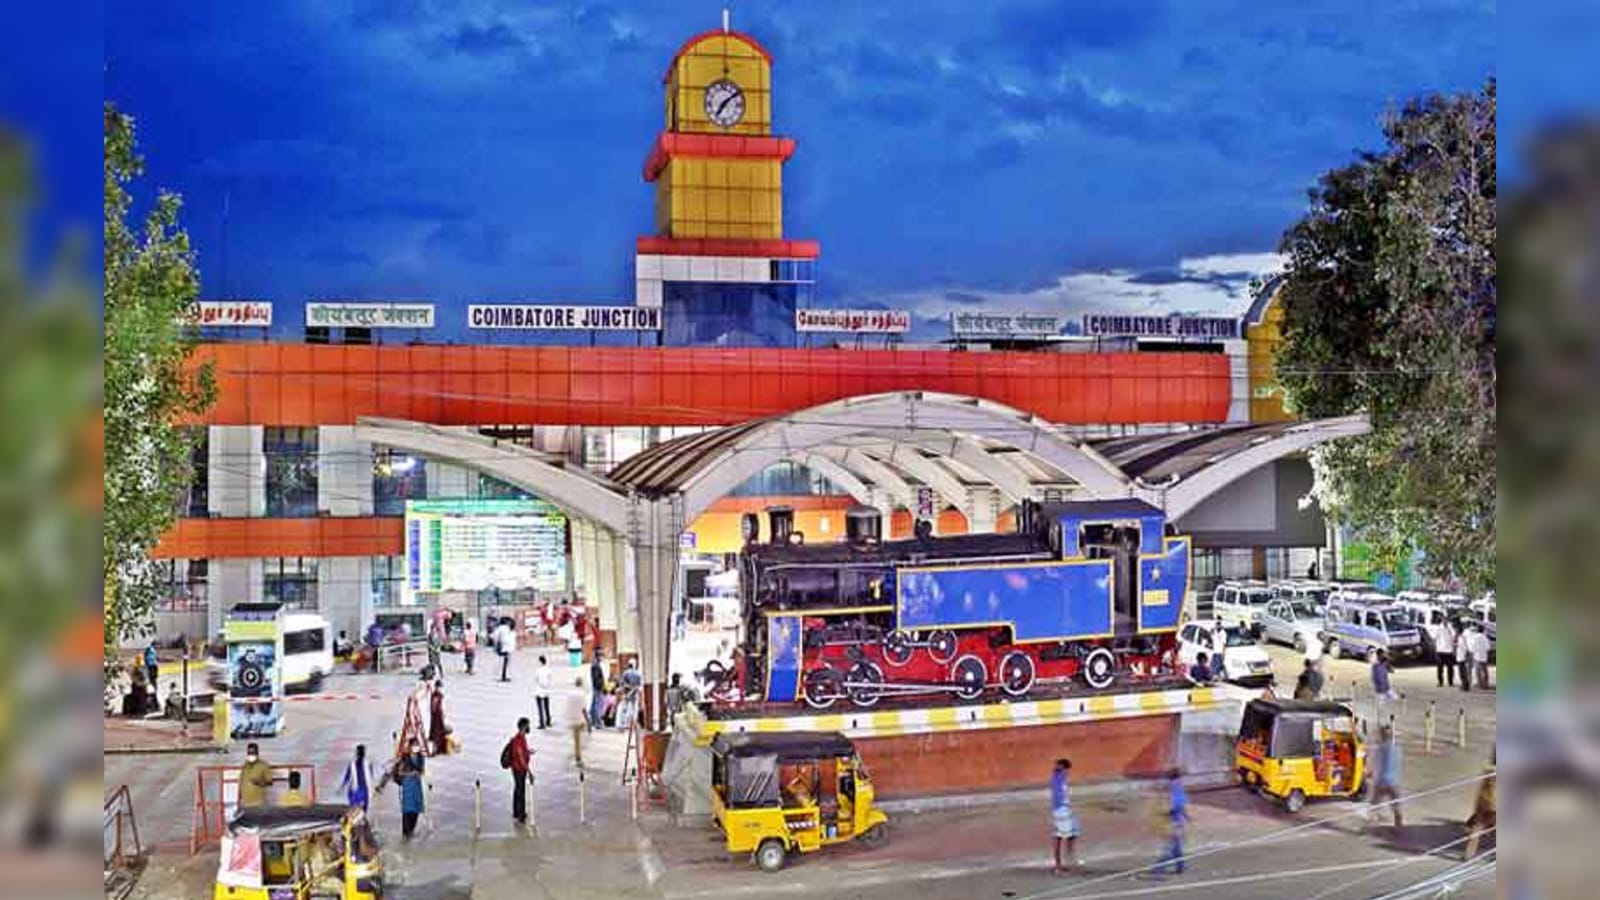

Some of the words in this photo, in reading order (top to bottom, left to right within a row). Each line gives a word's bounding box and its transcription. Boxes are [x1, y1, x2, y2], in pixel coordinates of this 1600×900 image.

[472, 307, 575, 327] COIMBATORE
[581, 308, 657, 328] JUNCTION
[1090, 316, 1173, 335] COIMBATORE
[1177, 318, 1237, 337] JUNCTION
